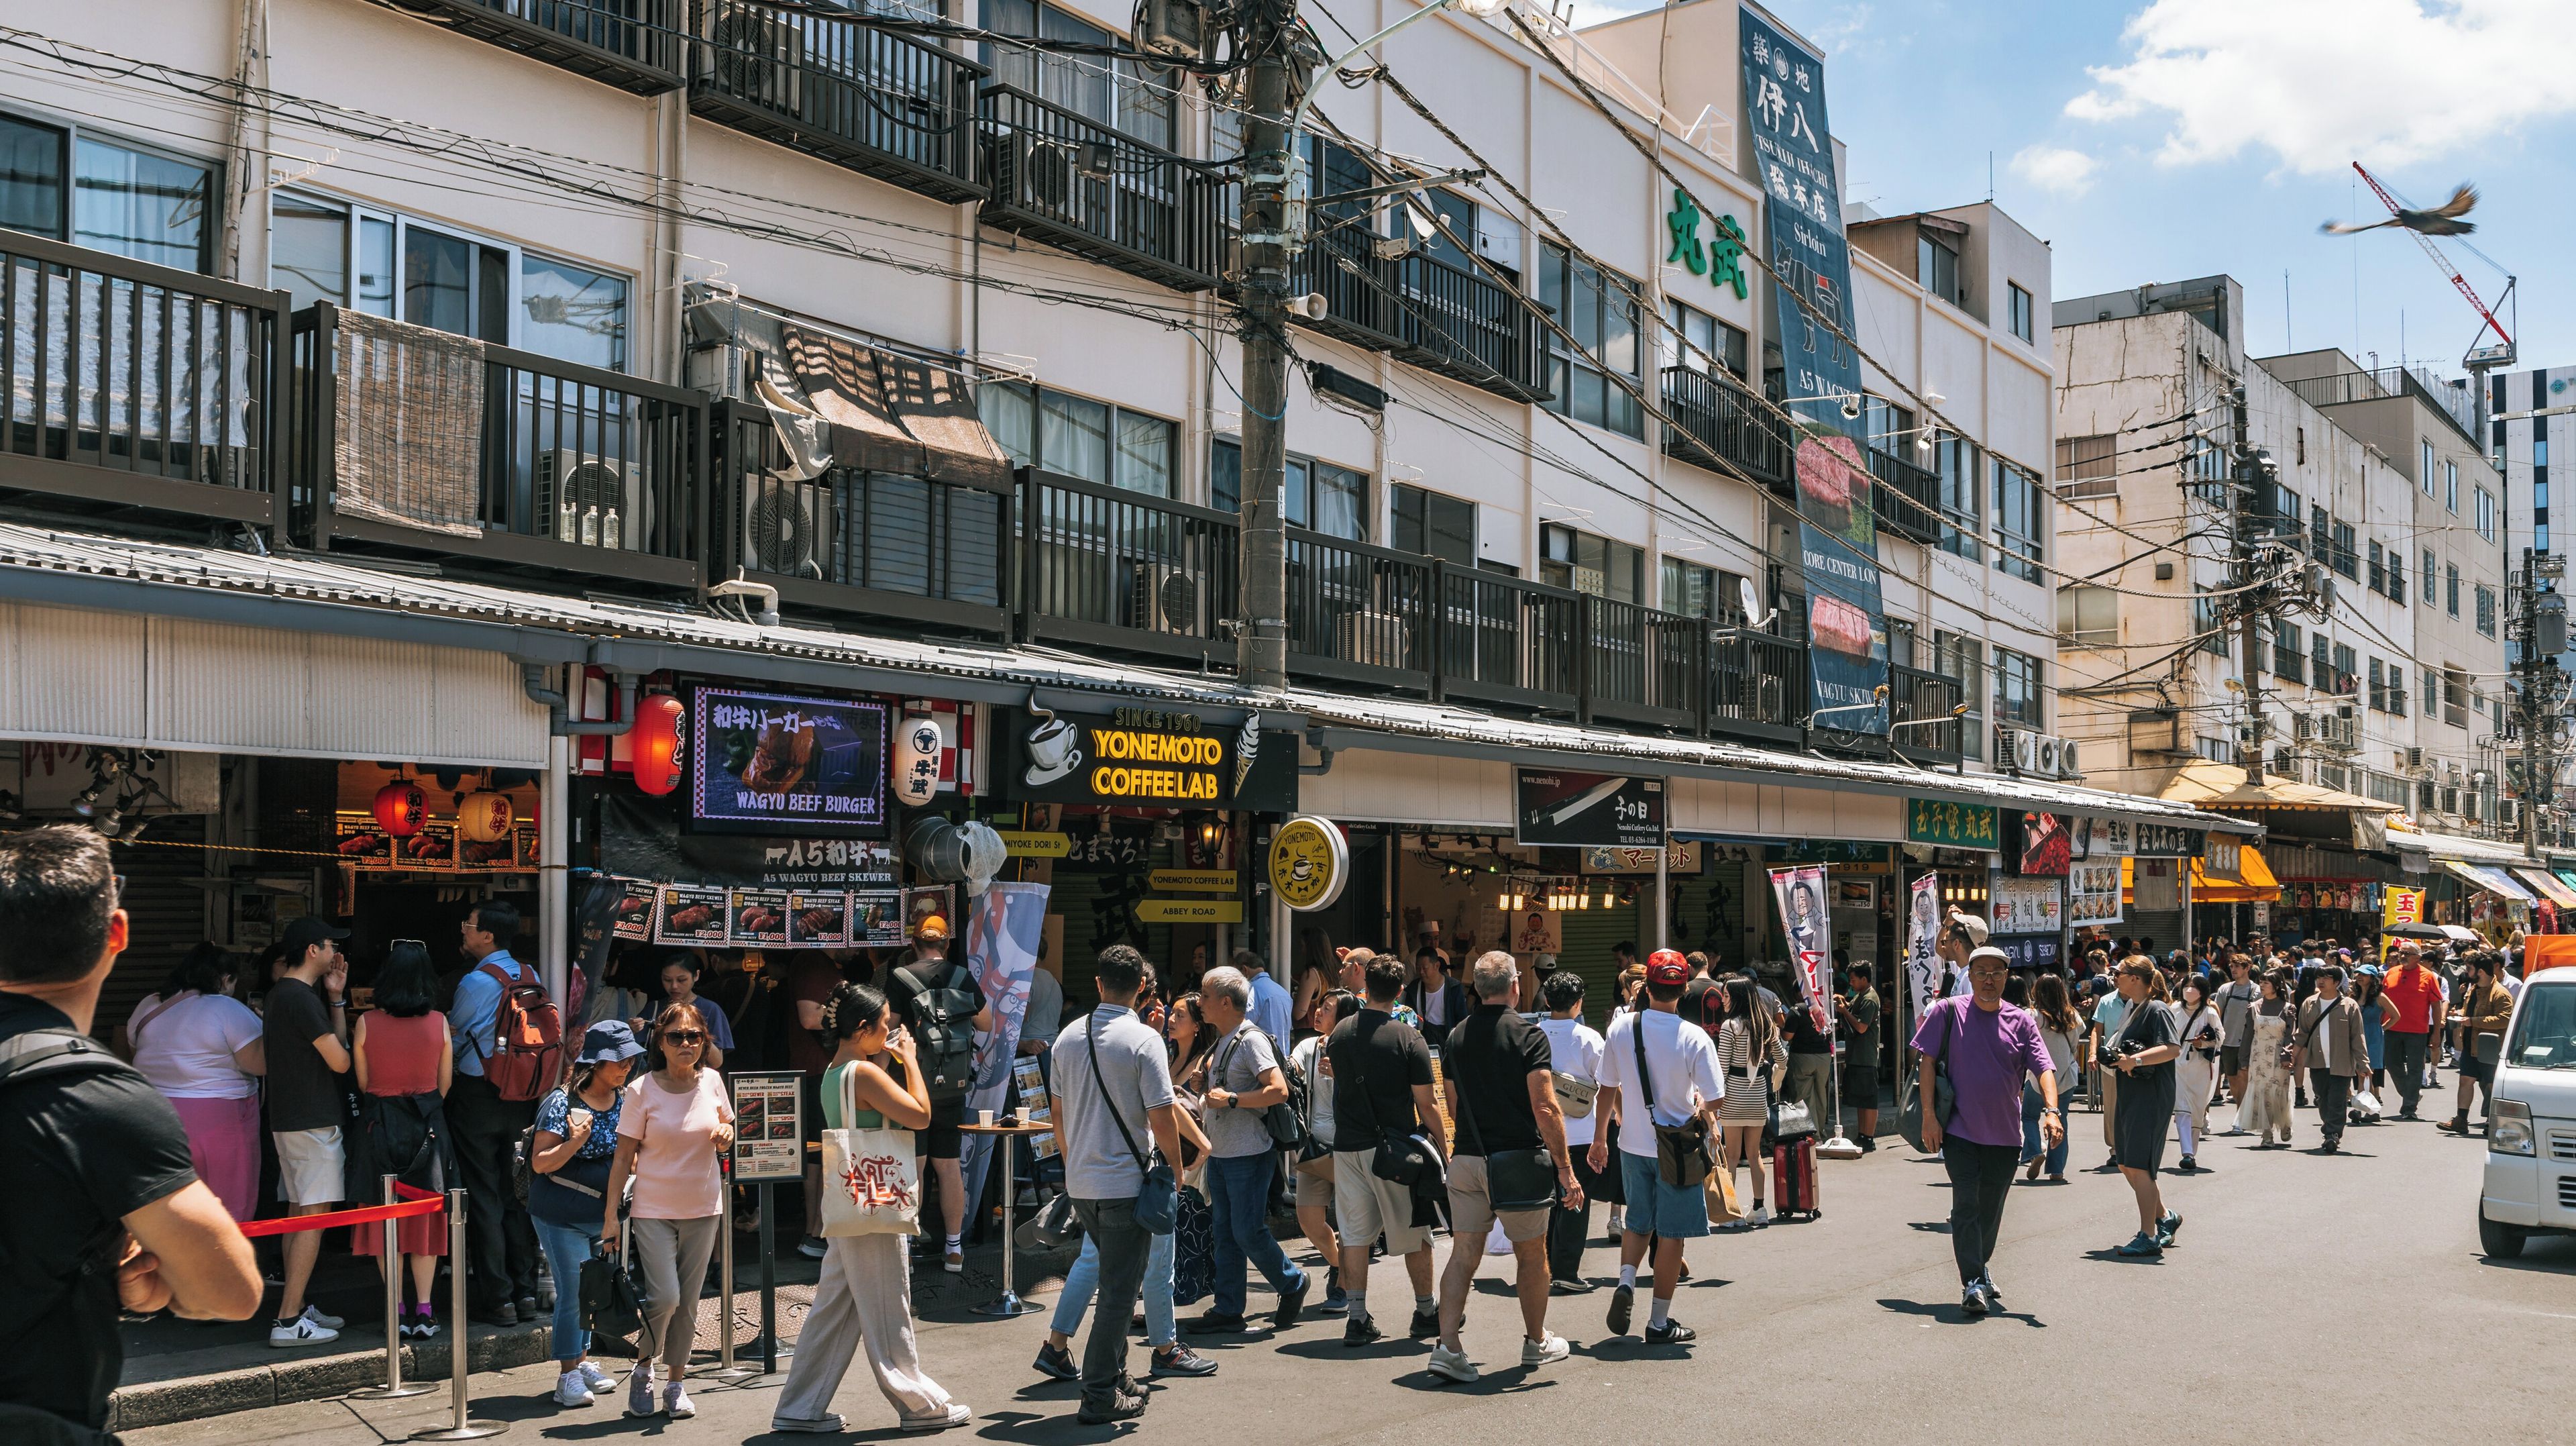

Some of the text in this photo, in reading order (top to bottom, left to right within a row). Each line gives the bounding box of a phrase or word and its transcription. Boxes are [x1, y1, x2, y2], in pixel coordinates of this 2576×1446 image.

[1757, 74, 1819, 153] 伊八
[1770, 164, 1827, 222] 総本店
[1667, 189, 1748, 299] 丸武
[1794, 221, 1827, 258] Sirloin
[1800, 368, 1814, 391] A5
[1804, 550, 1825, 570] CORE
[1827, 558, 1857, 579] CENTER
[1816, 679, 1847, 701] WAGYU
[713, 704, 815, 733] 和牛バーガー
[1116, 707, 1201, 732] SINCE 1960
[1091, 729, 1222, 766] YONEMOTO
[910, 759, 931, 796] 牛武
[1522, 776, 1561, 788] www.nenohi.jp
[405, 790, 423, 826] 和牛
[737, 792, 875, 814] WAGYU BEEF BURGER
[1615, 795, 1648, 821] 子の日
[489, 798, 508, 834] 和牛
[1283, 831, 1316, 845] YONEMOTO
[1631, 824, 1646, 833] Cutlery
[786, 839, 868, 867] A5和牛
[1034, 841, 1051, 849] DORI
[1622, 845, 1692, 868] マーット
[763, 872, 892, 882] A5 WAGYU BEEF SKEWER
[1153, 876, 1192, 884] YONEMOTO
[1995, 876, 2057, 895] Grilled Wagyu Beef
[1163, 907, 1189, 915] ABBEY
[614, 920, 643, 933] ¥3,000
[695, 930, 724, 939] ¥2,000
[758, 931, 786, 940] ¥1,000
[818, 932, 842, 941] ¥5,000
[1914, 935, 1934, 1007] まぐろ
[1562, 1083, 1589, 1098] GUCCI
[842, 1155, 896, 1187] ART
[849, 1180, 914, 1210] FLEA
